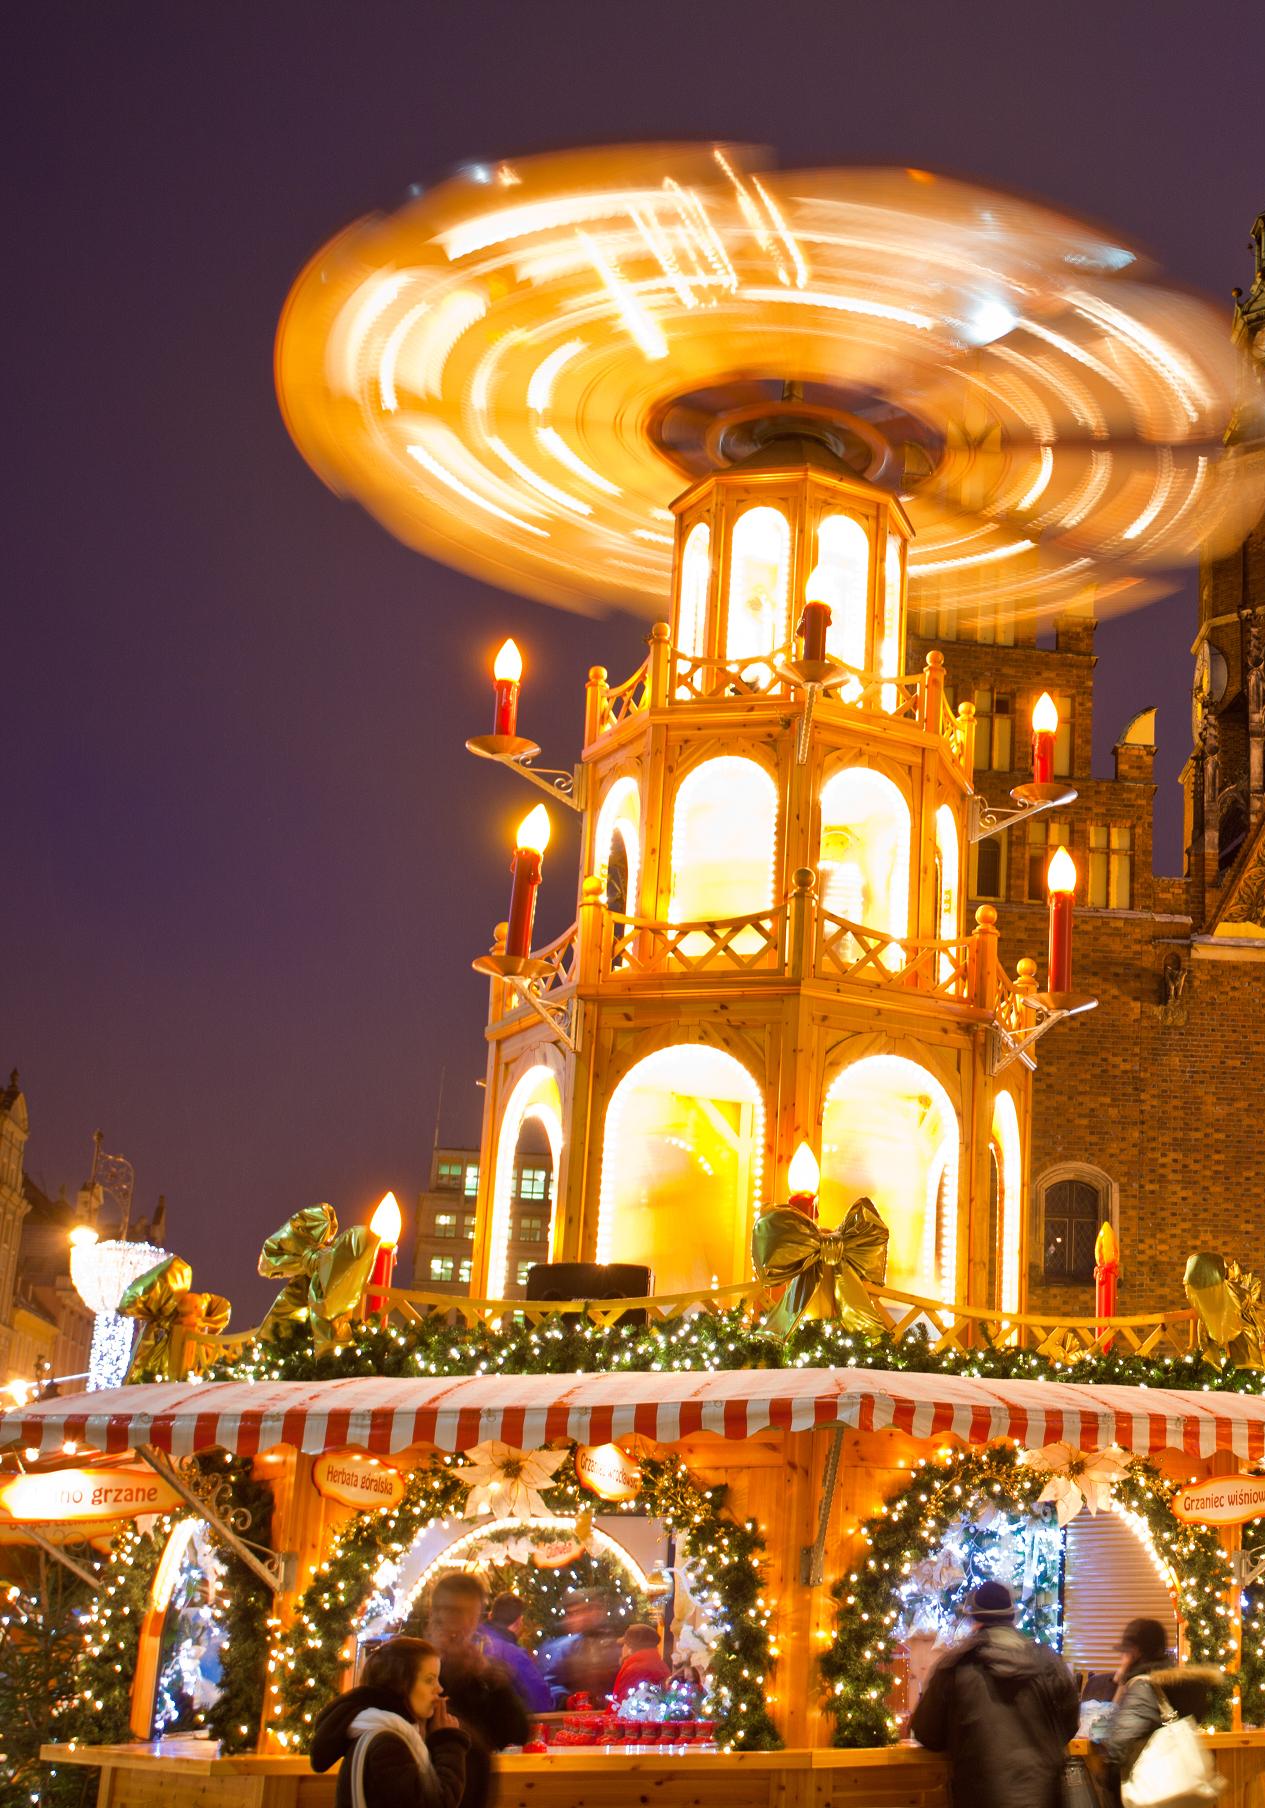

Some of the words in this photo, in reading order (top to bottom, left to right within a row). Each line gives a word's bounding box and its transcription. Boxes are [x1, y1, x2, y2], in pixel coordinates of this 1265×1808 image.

[327, 1464, 359, 1487] Herbata
[361, 1472, 393, 1496] góralska
[91, 1486, 158, 1505] grzane
[1183, 1492, 1225, 1511] Grzaniec
